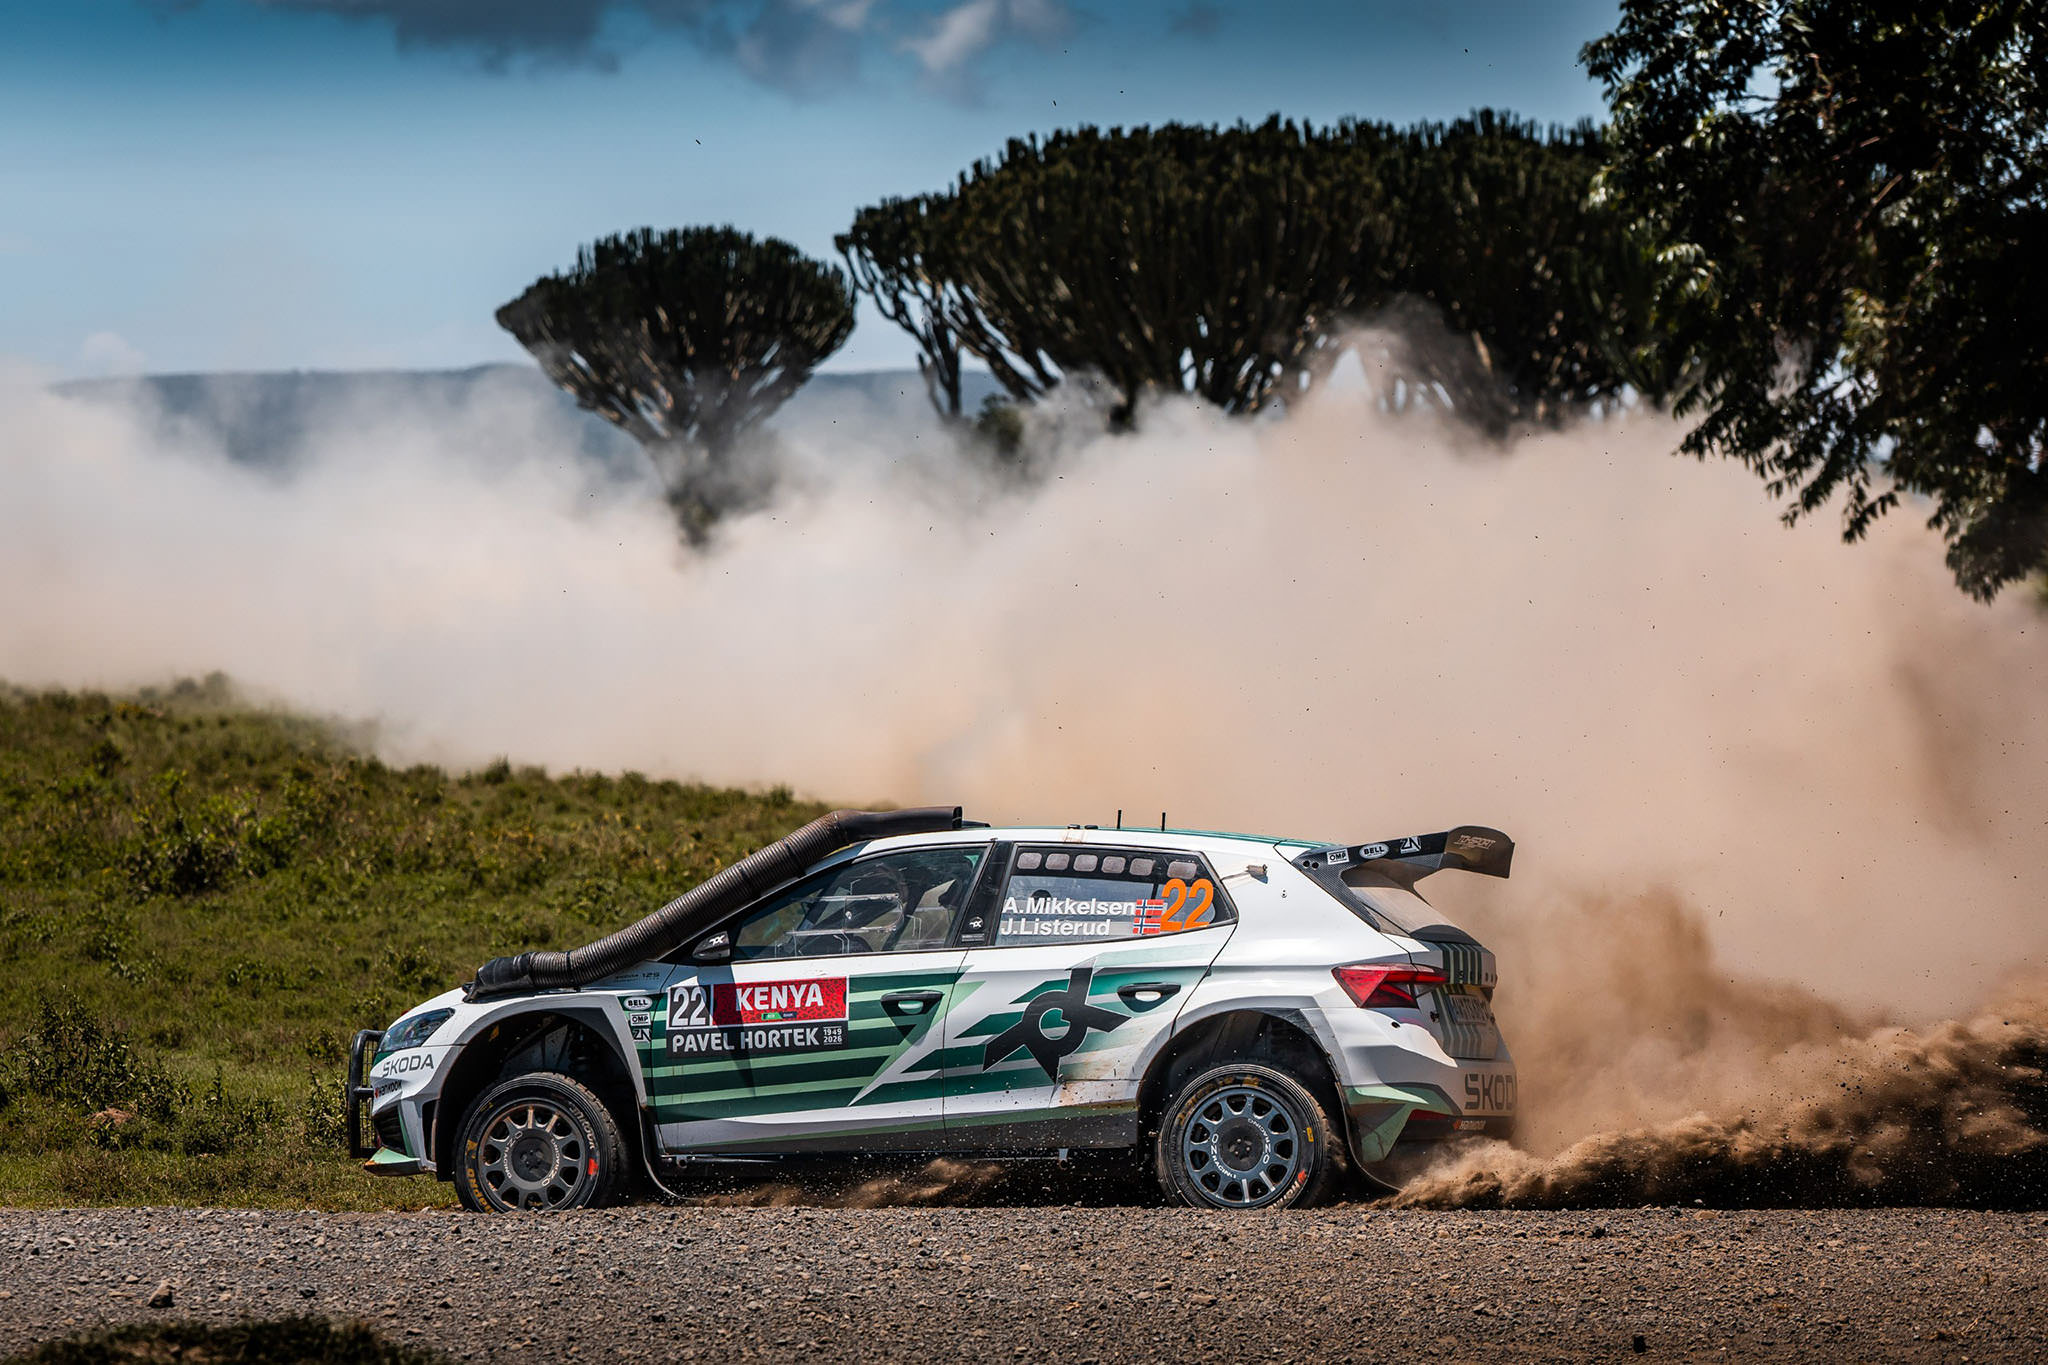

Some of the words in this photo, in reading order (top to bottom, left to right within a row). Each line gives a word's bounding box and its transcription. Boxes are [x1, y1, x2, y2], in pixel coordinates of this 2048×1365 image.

[1329, 852, 1346, 861] OMP
[1363, 847, 1385, 855] BELL
[1160, 878, 1214, 932] 22
[1000, 918, 1111, 936] J.Listerud
[671, 986, 707, 1026] 22
[735, 983, 824, 1012] KENYA
[672, 1032, 735, 1052] PAVEL
[740, 1027, 820, 1050] HORTEK
[823, 1028, 842, 1036] 1949
[823, 1035, 843, 1043] 2026
[1464, 1073, 1514, 1111] SKOD
